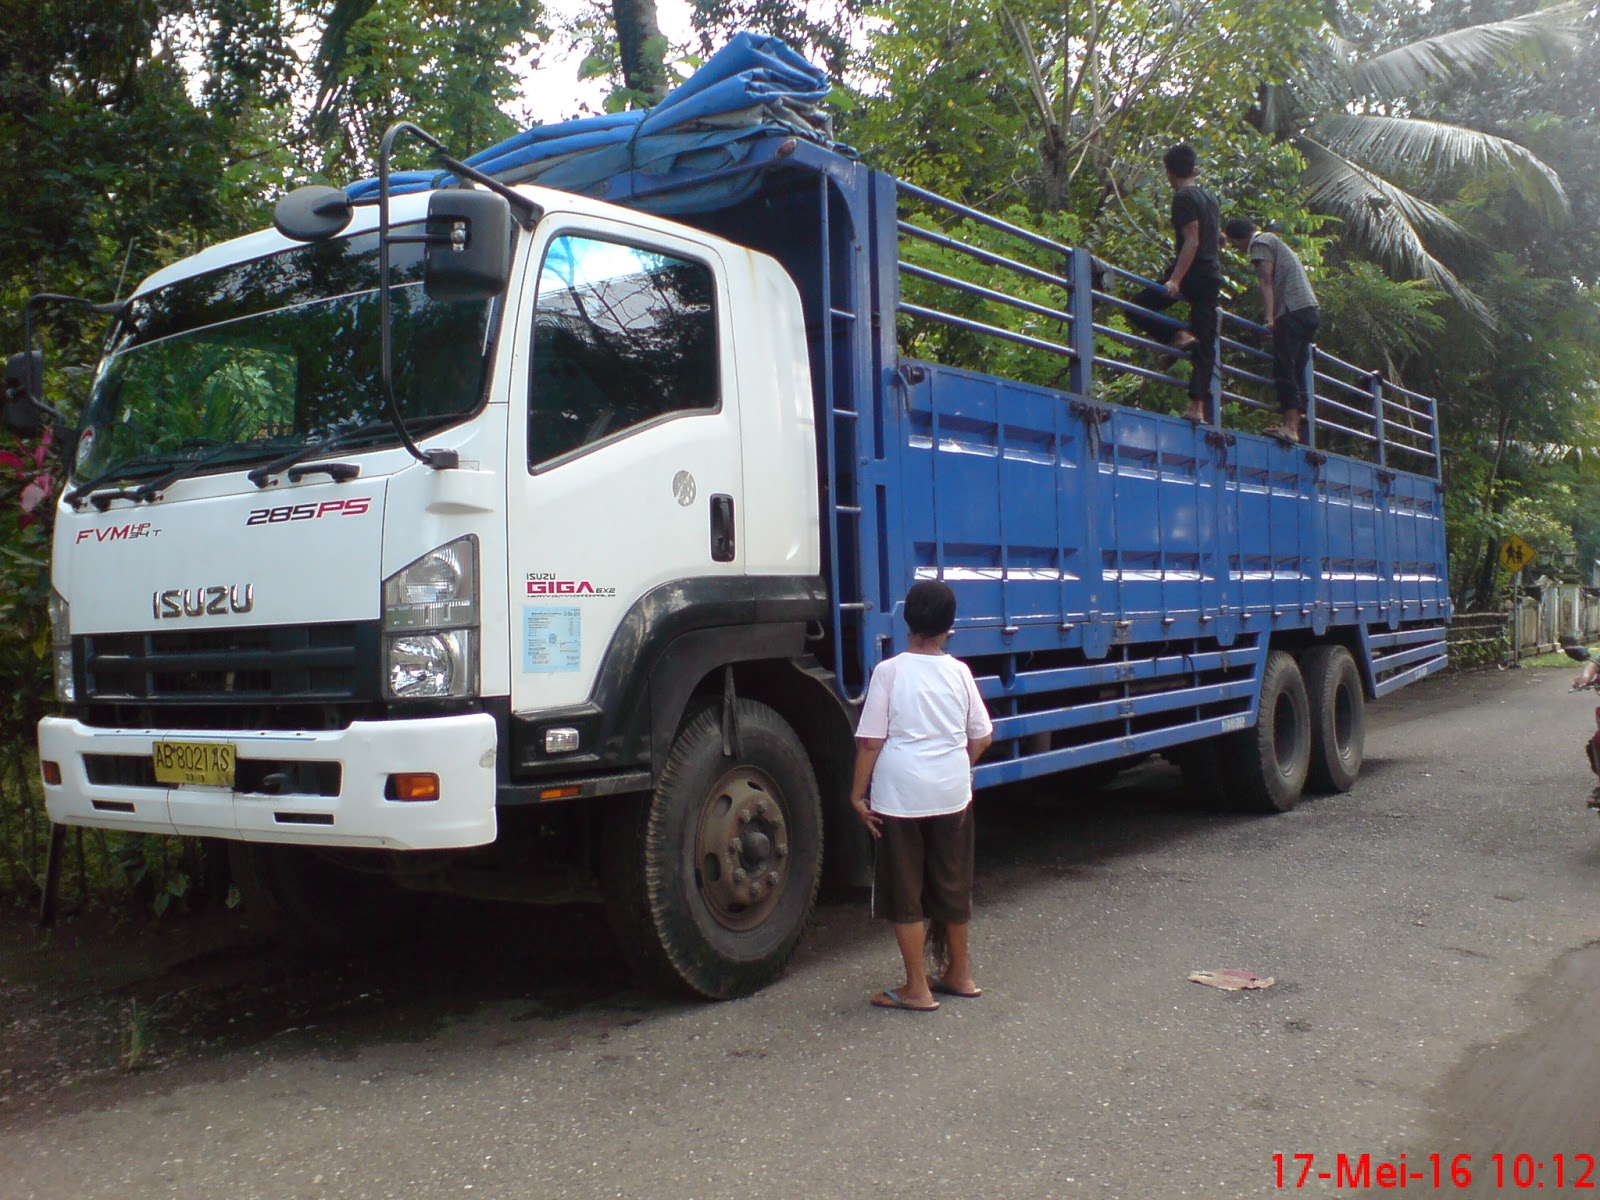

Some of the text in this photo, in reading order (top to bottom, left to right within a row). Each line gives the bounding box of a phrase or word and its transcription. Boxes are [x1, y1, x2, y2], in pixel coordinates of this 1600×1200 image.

[246, 497, 371, 526] 285PS
[76, 525, 130, 544] FVM
[131, 522, 151, 532] HP
[527, 582, 595, 594] GIGA
[153, 583, 254, 619] ISUZU
[156, 744, 229, 772] AB 8021 AS
